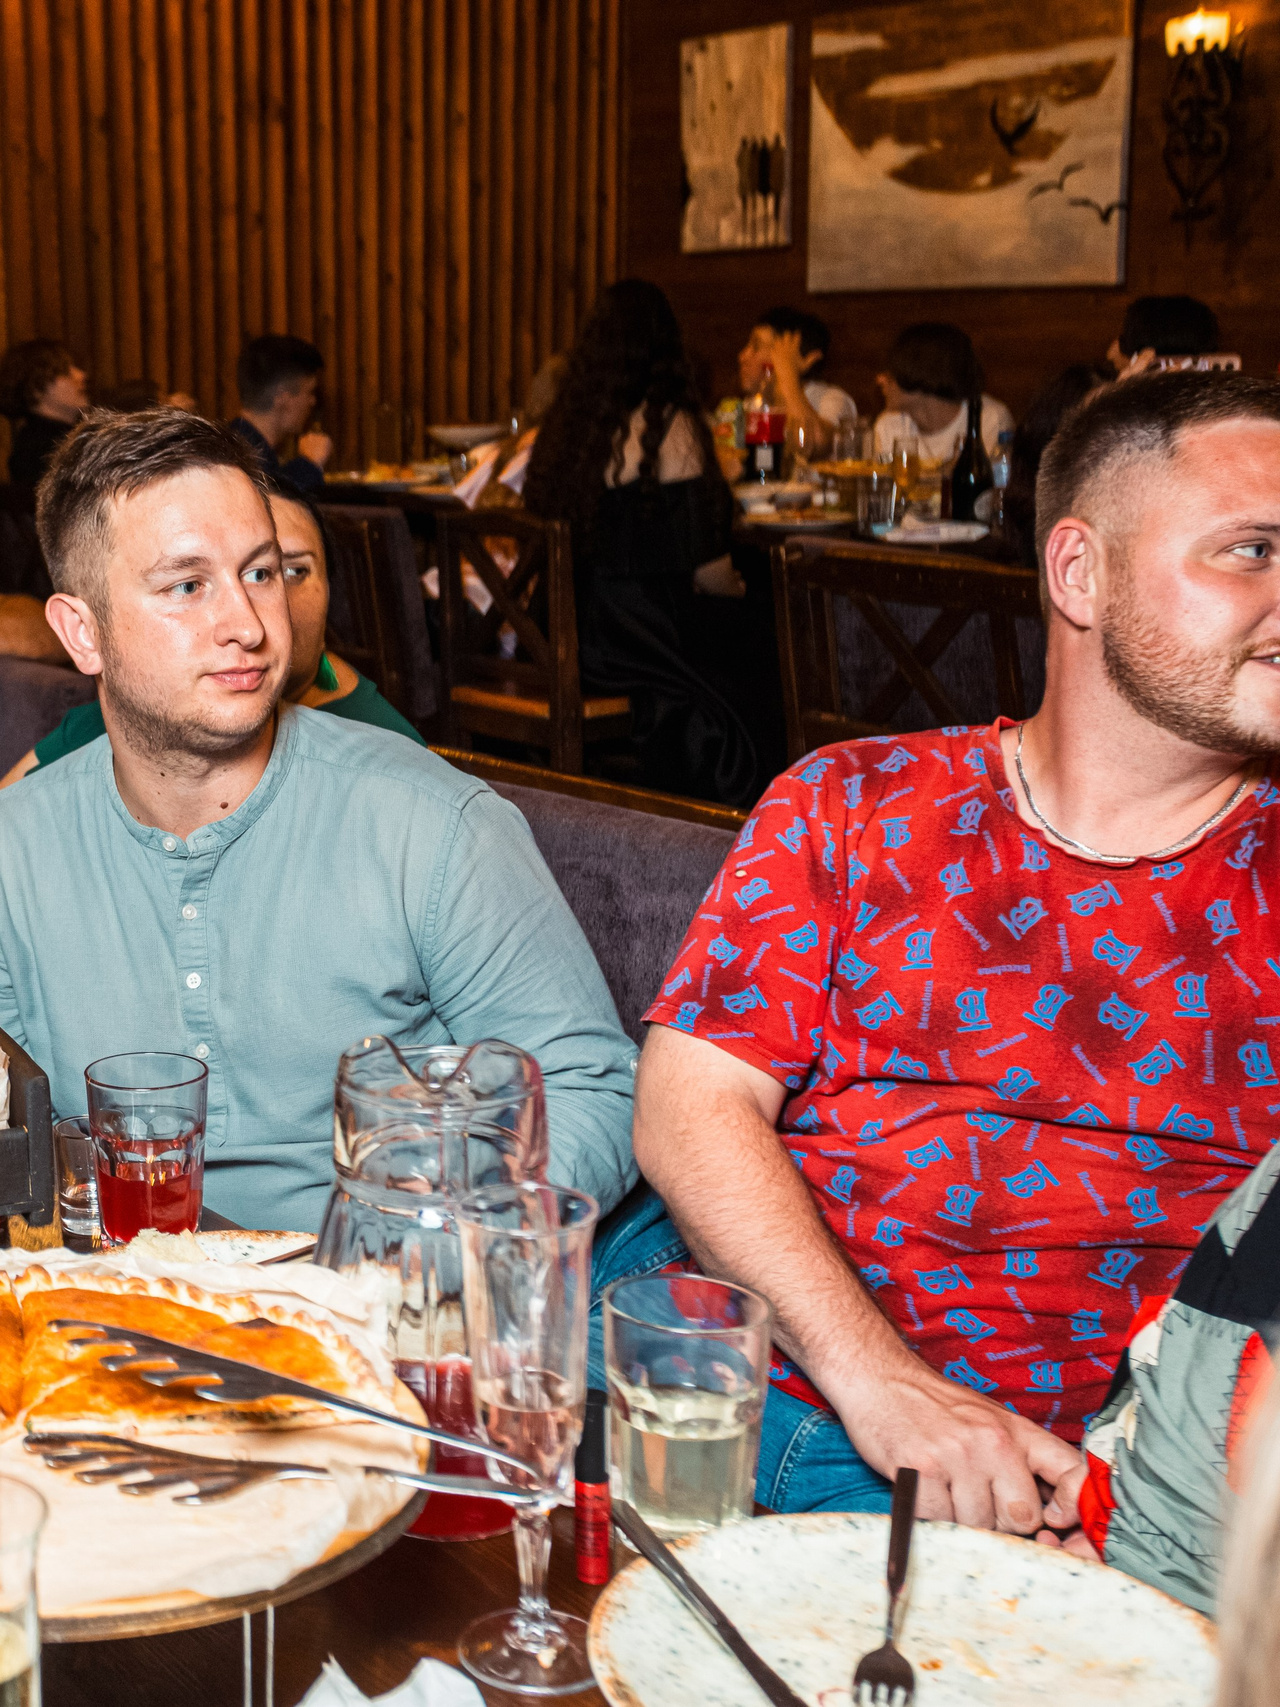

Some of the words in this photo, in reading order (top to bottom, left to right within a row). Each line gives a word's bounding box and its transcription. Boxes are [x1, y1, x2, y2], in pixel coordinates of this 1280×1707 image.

[933, 782, 982, 807] Barcelona
[982, 829, 1003, 875] Barcelona
[884, 857, 913, 894] Barcelona
[1251, 868, 1270, 916] Barcelona
[869, 913, 919, 947] Barcelona
[953, 910, 991, 951] Barcelona
[1057, 923, 1074, 973] Barcelona
[977, 964, 1031, 975] Barcelona
[1133, 954, 1187, 989] Barcelona
[1222, 951, 1262, 997] Barcelona
[782, 1000, 799, 1042] Barcelona
[917, 980, 934, 1029] Barcelona
[975, 1032, 1028, 1058] Barcelona
[1071, 1043, 1108, 1087] Barcelona
[1201, 1029, 1216, 1085] Barcelona
[1061, 1136, 1120, 1160] Barcelona
[1227, 1106, 1249, 1150] Barcelona
[967, 1136, 982, 1181] Barcelona
[880, 1173, 917, 1204] Barcelona
[1077, 1171, 1110, 1217] Barcelona
[989, 1217, 1051, 1235] Barcelona
[986, 1344, 1045, 1361] Barcelona
